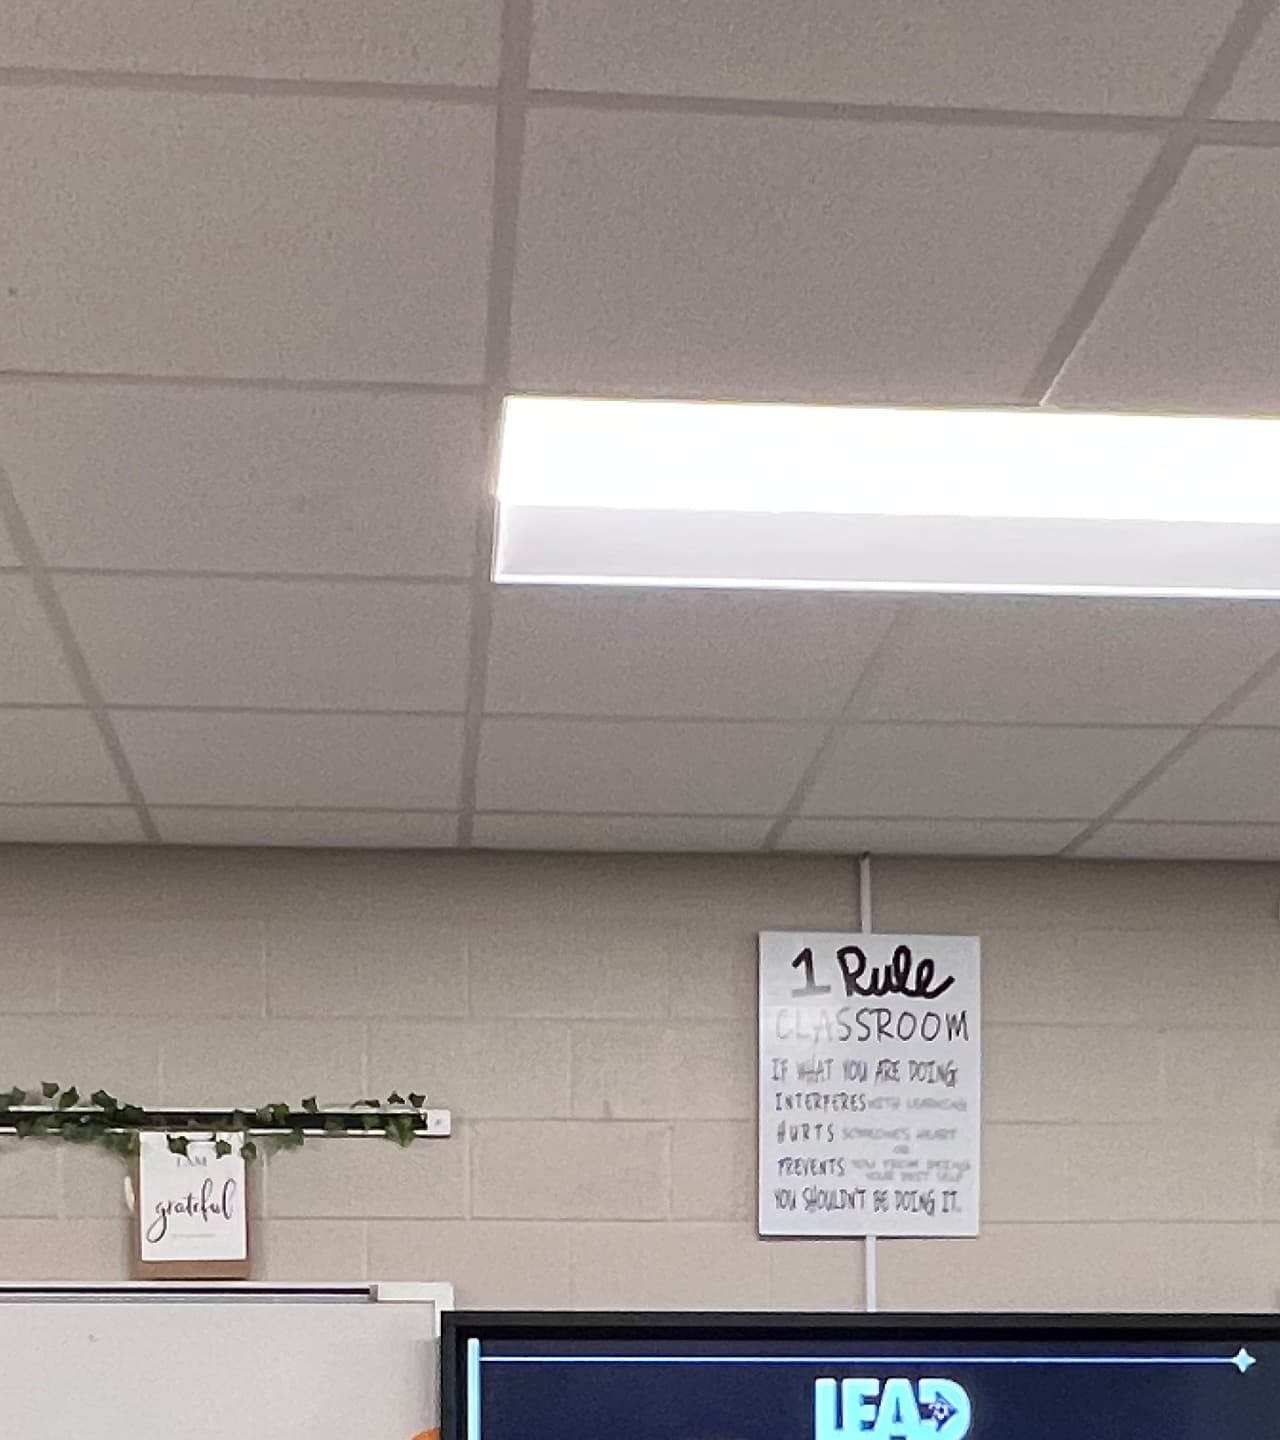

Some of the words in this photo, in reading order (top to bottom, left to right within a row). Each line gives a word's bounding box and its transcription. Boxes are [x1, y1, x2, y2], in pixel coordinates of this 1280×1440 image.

[792, 948, 831, 998] 1
[837, 945, 955, 999] Rule
[776, 1007, 969, 1042] CLASSROOM
[773, 1059, 788, 1081] IF
[797, 1055, 834, 1084] WHAT
[843, 1058, 867, 1083] YOU
[874, 1059, 900, 1084] ARE
[909, 1059, 957, 1087] DOING
[775, 1092, 867, 1112] INTERFERES
[777, 1122, 834, 1143] HURTS
[778, 1156, 844, 1177] PREVENTS
[146, 1177, 236, 1243] grateful
[774, 1190, 796, 1211] YOU
[873, 1189, 889, 1213] BE
[895, 1190, 936, 1217] DOING
